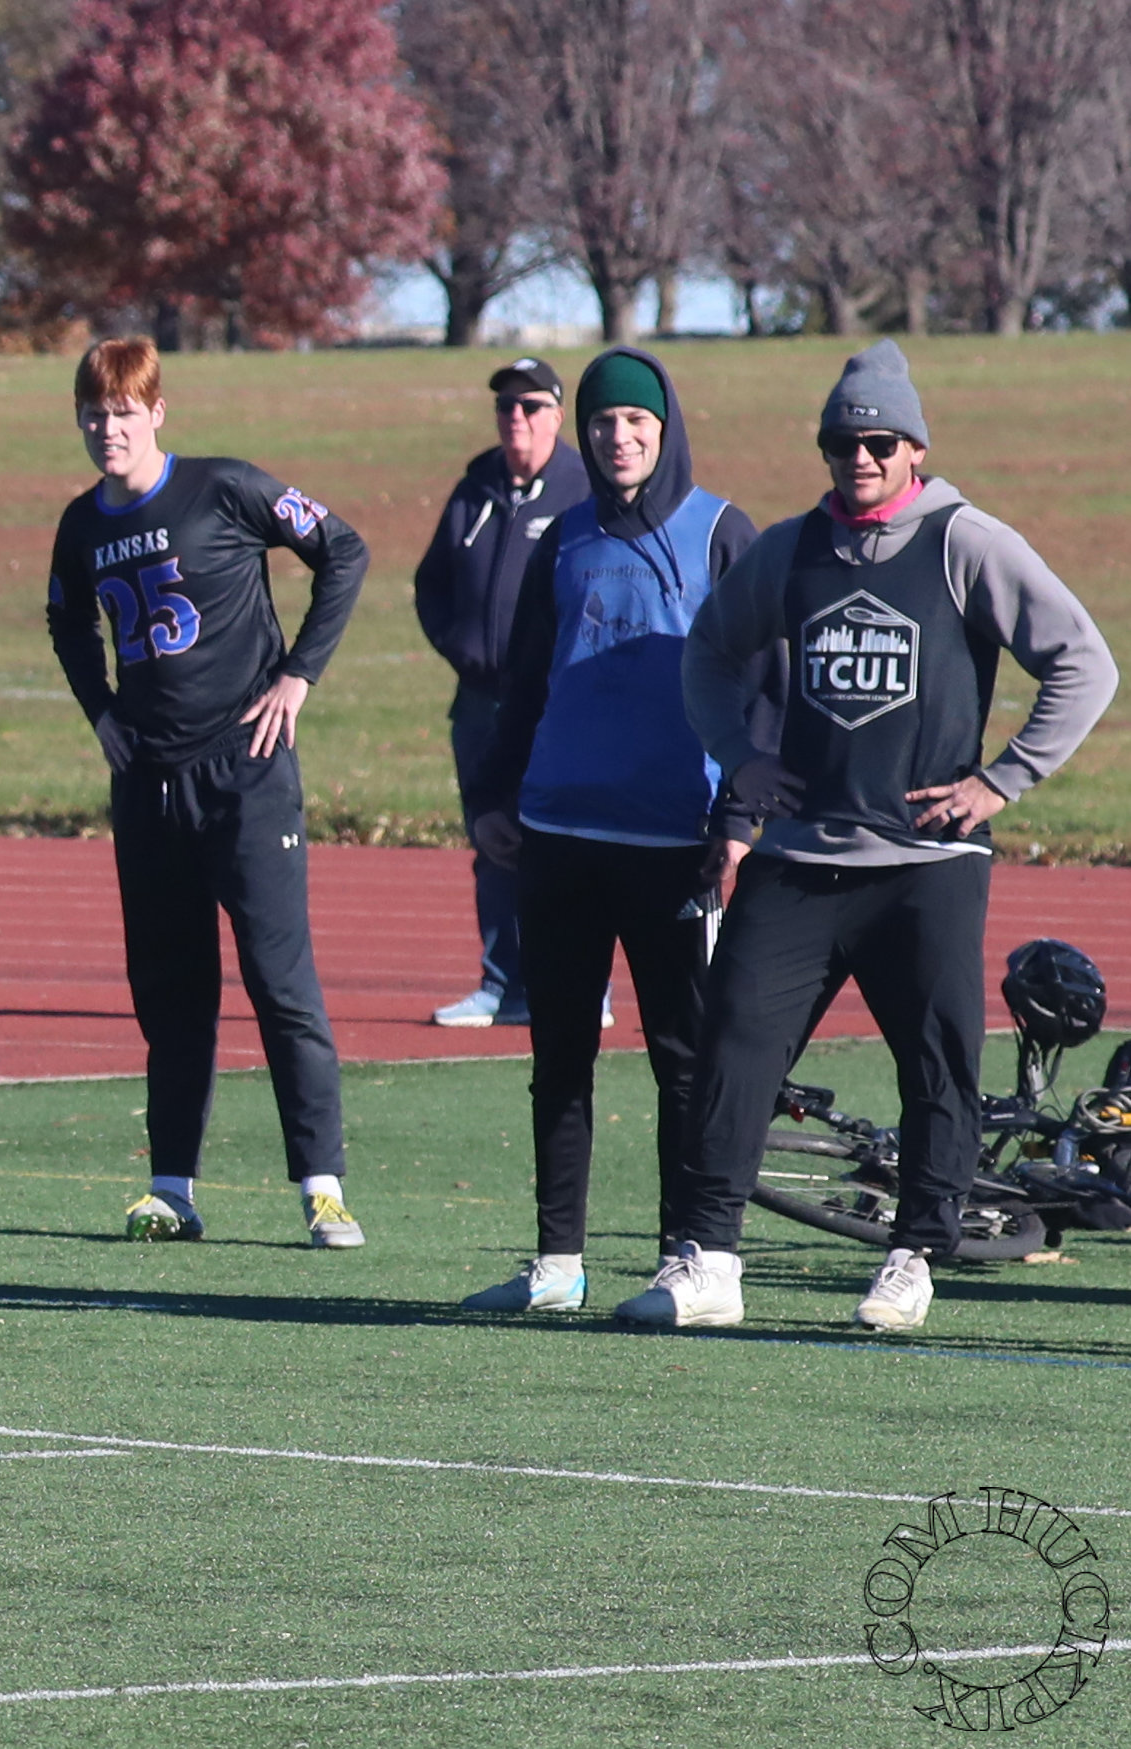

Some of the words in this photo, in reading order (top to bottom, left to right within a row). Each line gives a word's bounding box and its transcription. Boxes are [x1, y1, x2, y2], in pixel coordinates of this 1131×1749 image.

[94, 527, 169, 570] KANSAS
[96, 557, 201, 665] 25
[808, 656, 905, 691] TCUL
